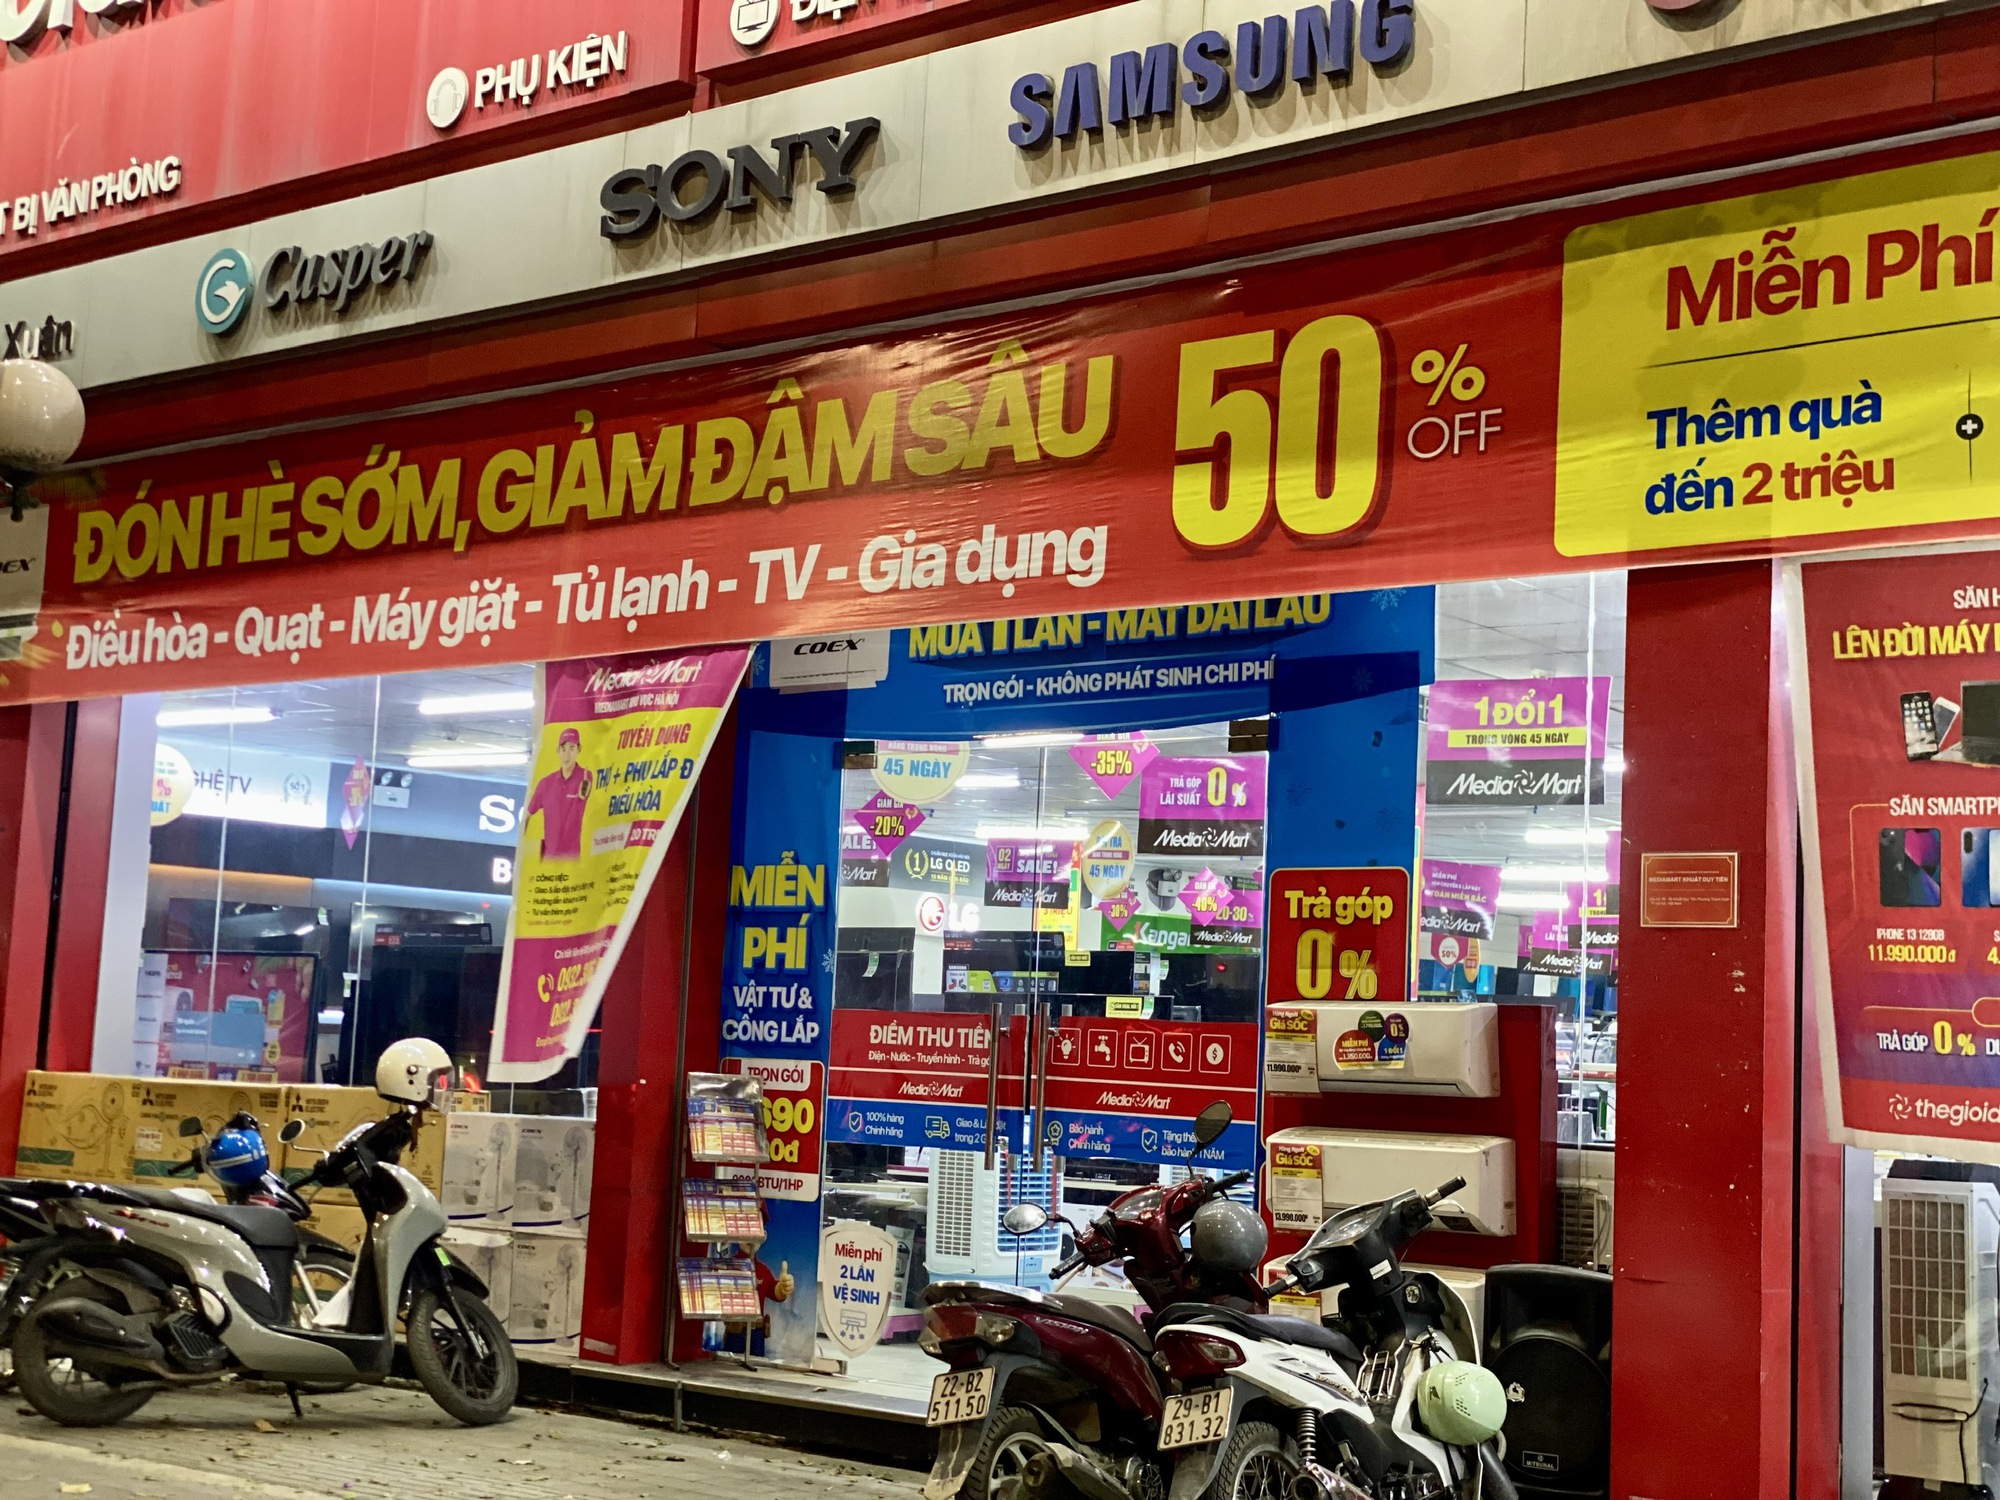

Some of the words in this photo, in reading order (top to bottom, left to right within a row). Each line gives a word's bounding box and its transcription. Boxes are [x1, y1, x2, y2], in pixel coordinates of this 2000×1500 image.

[473, 53, 542, 107] PHỤ
[546, 30, 628, 88] KIỆN
[1007, 0, 1414, 149] SAMSUNG
[599, 115, 881, 238] SONY
[13, 193, 39, 235] BỊ
[42, 177, 91, 223] VĂN
[91, 158, 182, 211] PHÒNG
[258, 229, 434, 312] Casper
[1665, 226, 1851, 331] Miễn
[1866, 207, 1999, 300] Phí
[1646, 397, 1781, 450] Thêm
[1788, 379, 1882, 440] quà
[1172, 314, 1383, 546] 50
[1410, 343, 1486, 406] %
[1406, 407, 1503, 459] OFF
[73, 478, 204, 585] ĐÓN
[206, 459, 295, 566] HÈ
[298, 443, 471, 556] SỚM,
[477, 409, 684, 534] GIẢM
[689, 377, 899, 506] ĐẬM
[904, 338, 1114, 477] SÂU
[1644, 457, 1734, 516] đến
[1742, 462, 1774, 505] 2
[1780, 449, 1896, 508] triệu
[66, 608, 141, 670] Điều
[143, 610, 208, 662] hòa
[234, 604, 325, 664] Quạt
[351, 586, 437, 650] Máy
[439, 577, 520, 648] giặt
[551, 564, 606, 625] Tủ
[609, 558, 708, 633] lạnh
[748, 543, 822, 604] TV
[858, 529, 948, 594] Gia
[954, 523, 1109, 598] dụng
[1953, 584, 1990, 610] SĂN
[793, 637, 862, 658] COEX
[1832, 624, 1879, 660] LÊN
[1882, 621, 1925, 658] ĐỜI
[1929, 618, 1990, 655] MÁY
[942, 682, 993, 708] TRỌN
[994, 673, 1024, 700] GÓI
[1036, 671, 1103, 697] KHÔNG
[1104, 664, 1153, 692] PHÁT
[1155, 664, 1202, 689] SINH
[1204, 659, 1240, 684] CHI
[1241, 653, 1277, 682] PHÍ
[1474, 696, 1489, 726] 1
[1492, 688, 1546, 726] ĐỔI
[1548, 693, 1563, 725] 1
[1500, 731, 1528, 745] VÒNG
[1529, 732, 1542, 744] 45
[1544, 731, 1570, 744] NGÀY
[883, 757, 904, 776] 45
[909, 757, 952, 779] NGÀY
[1090, 749, 1133, 776] -35%
[229, 775, 253, 795] TV
[1159, 791, 1175, 805] LÃI
[1176, 790, 1202, 806] SUẤT
[1186, 776, 1202, 789] GÓP
[1207, 766, 1228, 807] 0
[1446, 772, 1514, 796] Media
[1531, 772, 1582, 796] Mart
[1889, 794, 1924, 817] SĂN
[869, 815, 905, 837] -20%
[730, 850, 825, 907] MIỄN
[930, 857, 943, 870] LG
[948, 901, 980, 933] LG
[1284, 886, 1331, 919] Trả
[1335, 886, 1393, 925] góp
[742, 912, 811, 969] PHÍ
[1906, 928, 1917, 941] 13
[1295, 928, 1333, 999] 0
[1339, 949, 1378, 999] %
[732, 979, 767, 1013] VẬT
[769, 982, 798, 1009] TƯ
[798, 986, 813, 1010] &
[722, 1013, 778, 1042] CÔNG
[780, 1014, 820, 1044] LẮP
[870, 1019, 914, 1046] ĐIỂM
[916, 1026, 954, 1048] THU
[1876, 1029, 1902, 1051] TRẢ
[1901, 1032, 1929, 1052] GÓP
[1933, 1021, 1953, 1054] 0
[1957, 1033, 1975, 1056] %
[868, 1050, 886, 1064] Điện
[890, 1051, 911, 1063] Nước
[916, 1050, 944, 1065] Truyền
[944, 1052, 961, 1065] hình
[780, 1065, 804, 1084] GÓI
[865, 1125, 886, 1136] Chính
[866, 1111, 886, 1122] 100%
[886, 1113, 905, 1126] hàng
[955, 1117, 973, 1128] Giao
[1084, 1123, 1104, 1136] hành
[1068, 1138, 1091, 1150] Chính
[834, 1241, 861, 1260] Miễn
[863, 1244, 883, 1262] phí
[839, 1265, 848, 1279] 2
[849, 1263, 875, 1283] LẦN
[833, 1282, 849, 1304] VỆ
[849, 1289, 880, 1305] SINH
[940, 1371, 983, 1398] 22-B2
[931, 1395, 987, 1423] 511.50
[1171, 1391, 1221, 1421] 29-B1
[1163, 1415, 1223, 1446] 831.32
